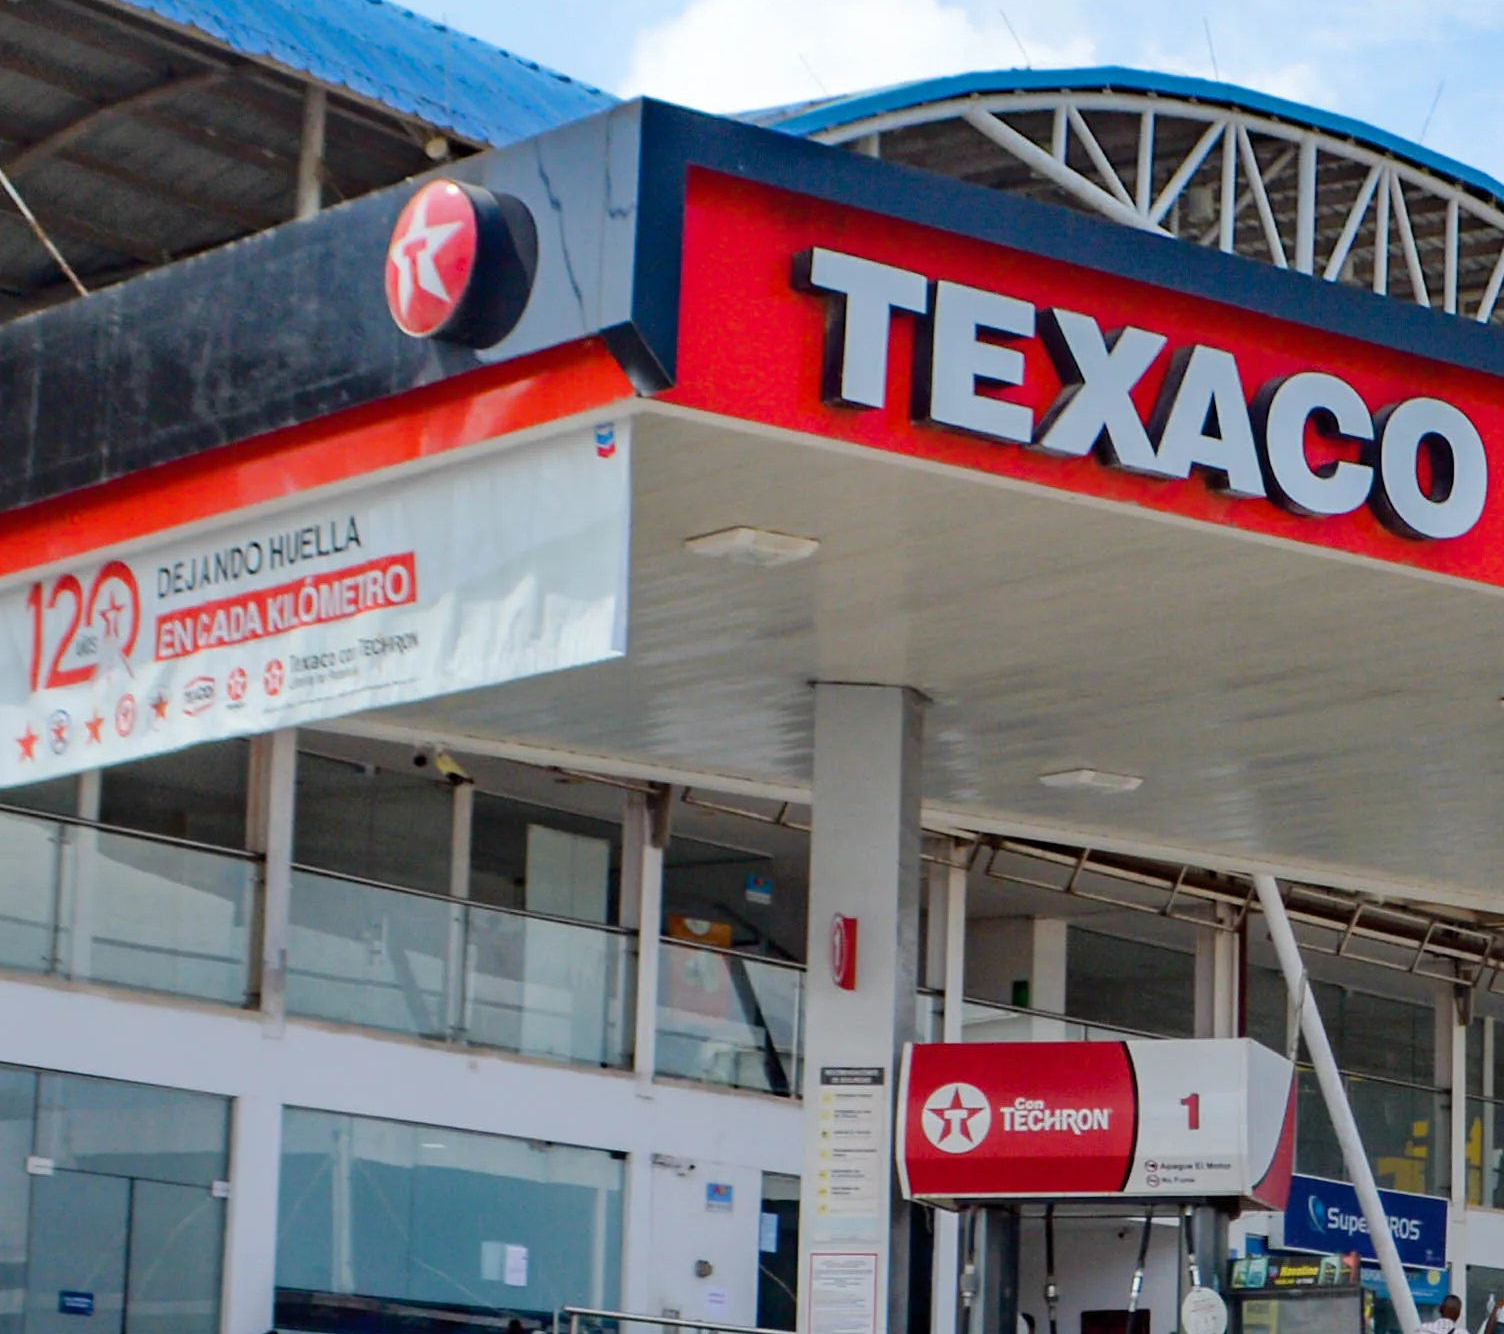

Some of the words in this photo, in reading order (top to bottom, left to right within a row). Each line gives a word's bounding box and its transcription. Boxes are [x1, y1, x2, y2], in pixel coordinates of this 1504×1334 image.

[804, 247, 1490, 541] TEXACO
[157, 542, 263, 600] DEJANDO
[269, 515, 363, 571] HUELLA
[159, 618, 194, 658] EN
[196, 603, 264, 648] CADA
[267, 564, 411, 633] KILÓMETRO
[1000, 1107, 1110, 1135] TECHRON
[1014, 1097, 1044, 1110] Con
[1179, 1093, 1200, 1131] 1
